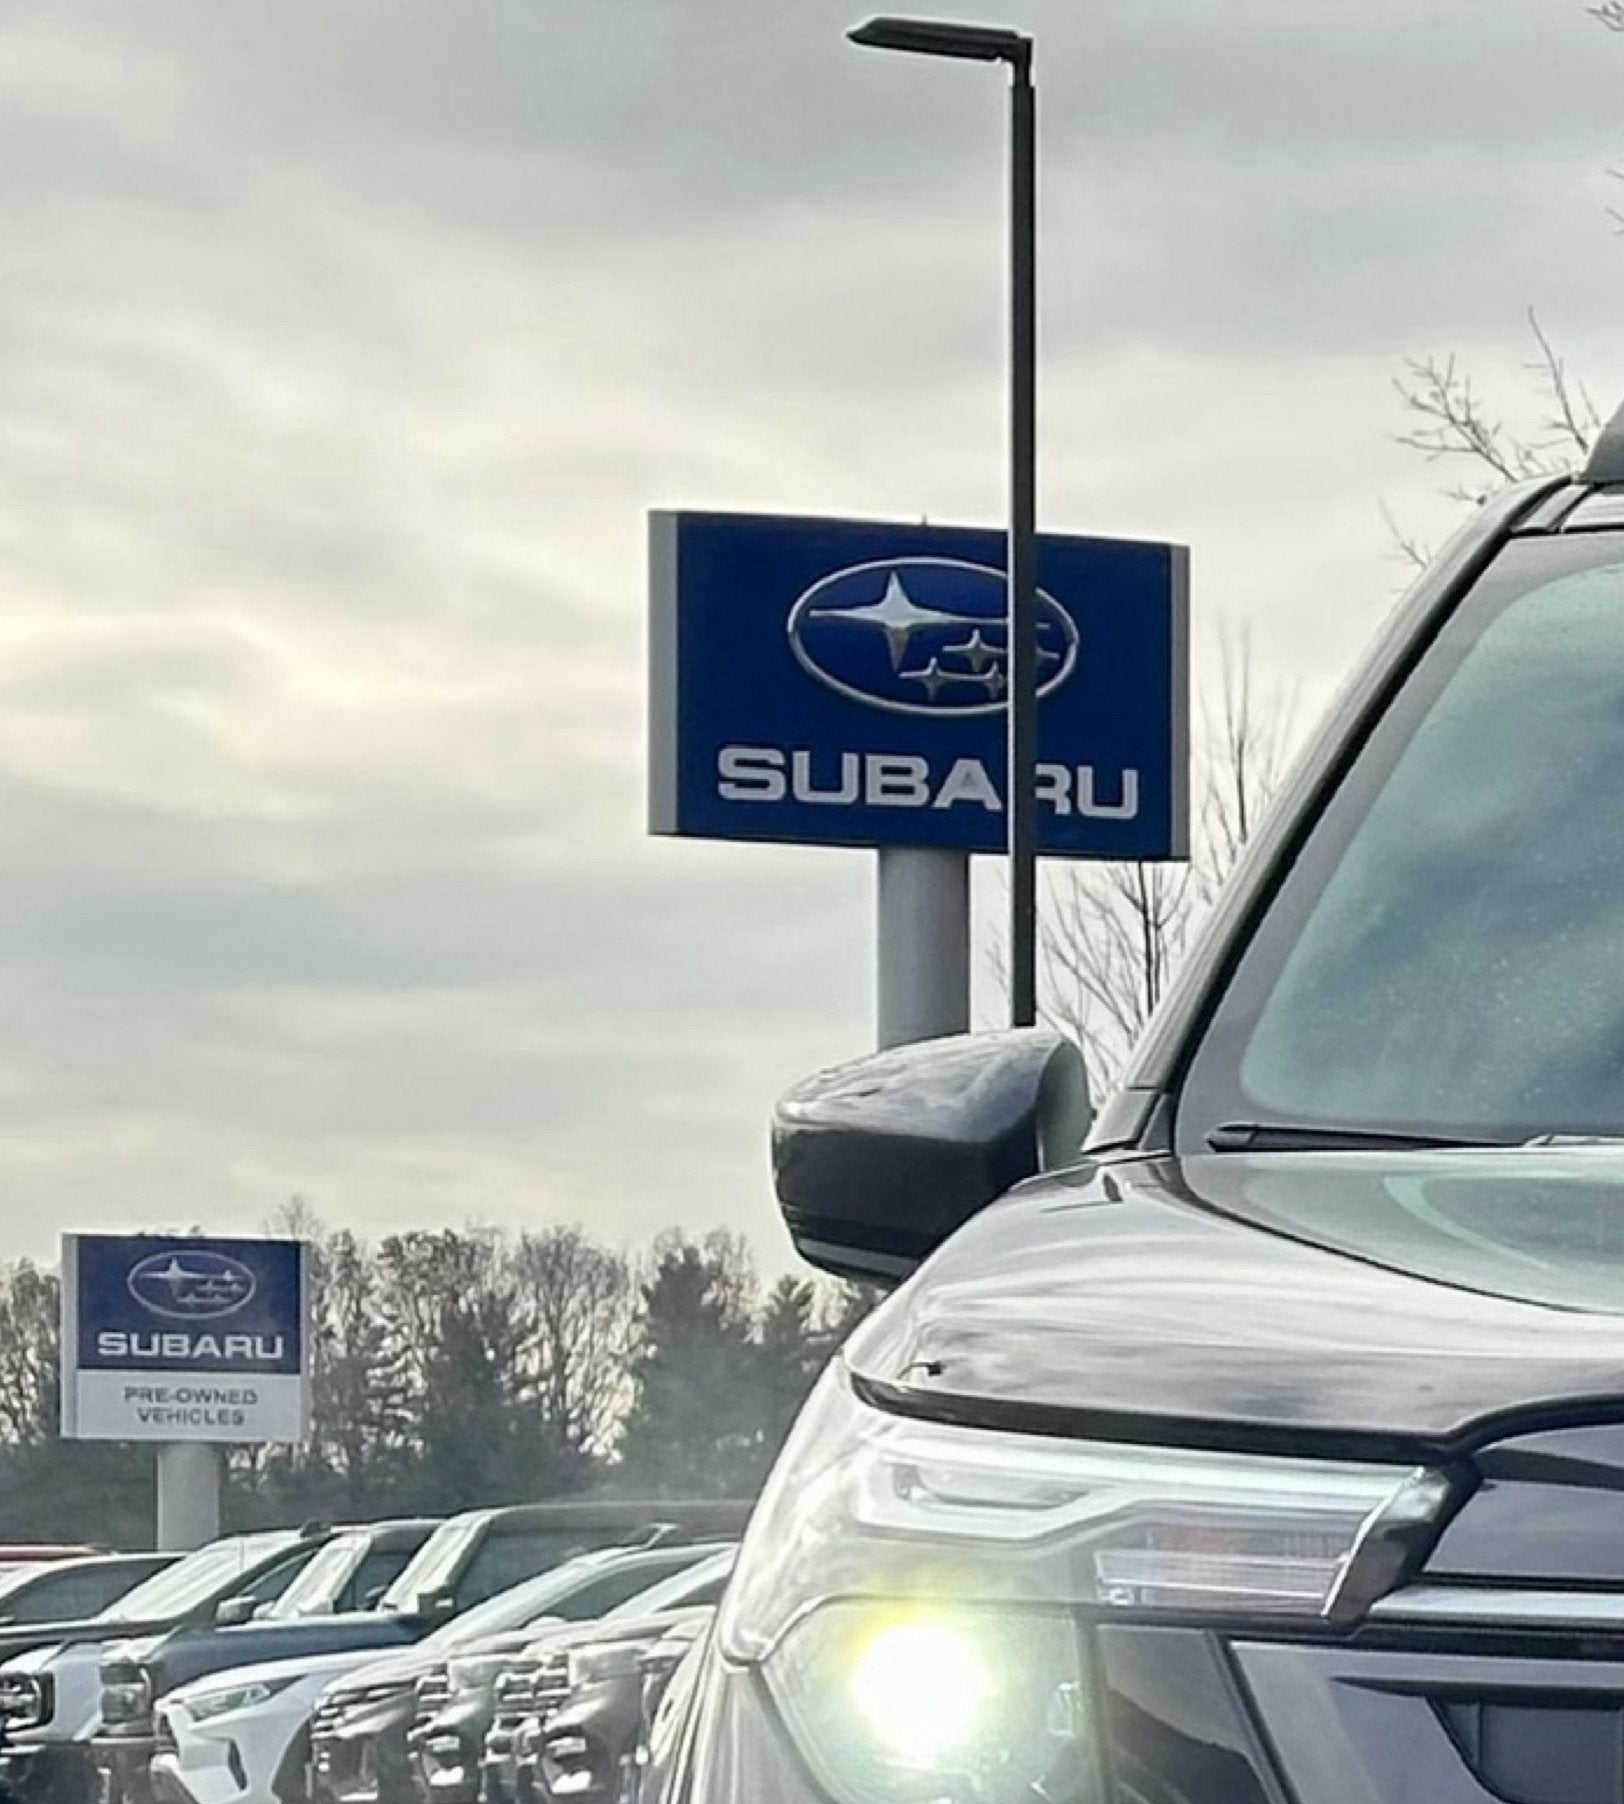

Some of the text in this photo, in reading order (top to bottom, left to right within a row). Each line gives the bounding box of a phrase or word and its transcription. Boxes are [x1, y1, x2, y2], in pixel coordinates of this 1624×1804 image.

[97, 1332, 284, 1360] SUBARU
[124, 1387, 258, 1405] PRE-OWNED
[137, 1407, 245, 1426] VEHICLES
